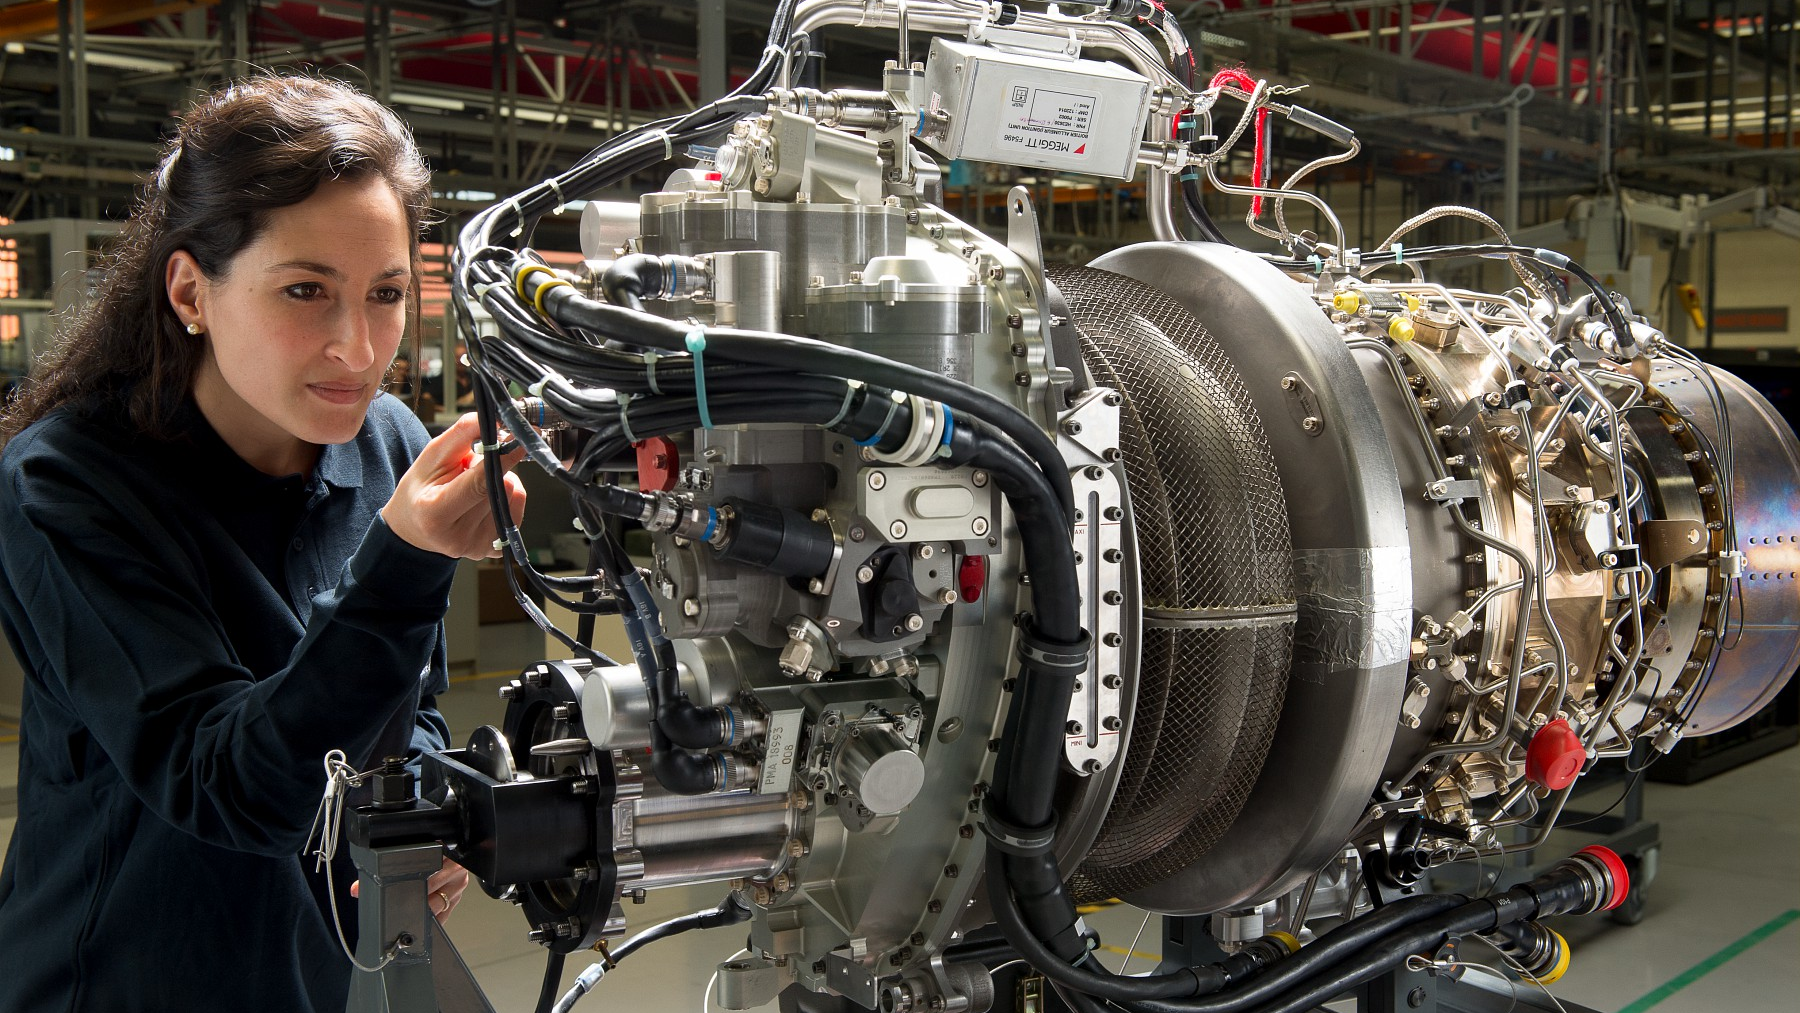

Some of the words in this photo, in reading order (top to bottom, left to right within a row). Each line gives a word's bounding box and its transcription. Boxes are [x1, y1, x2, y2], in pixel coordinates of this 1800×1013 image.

[1003, 134, 1024, 143] F5496
[1044, 129, 1070, 137] ALLUMEUR
[781, 744, 794, 765] 008
[765, 763, 778, 785] PMA
